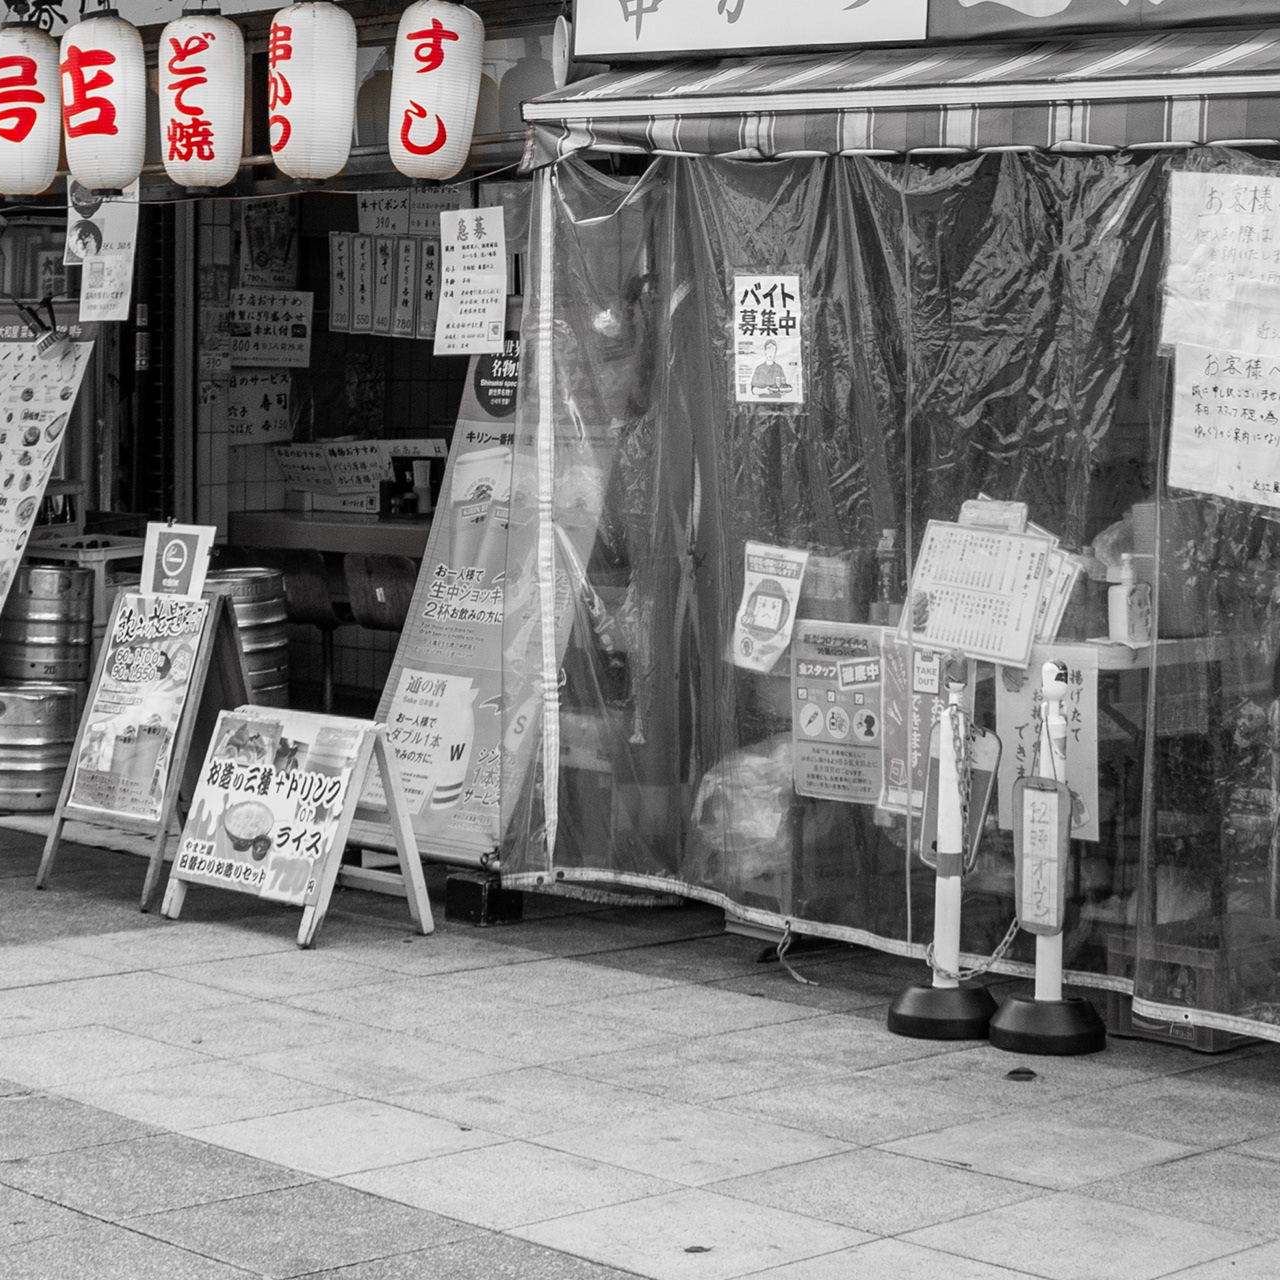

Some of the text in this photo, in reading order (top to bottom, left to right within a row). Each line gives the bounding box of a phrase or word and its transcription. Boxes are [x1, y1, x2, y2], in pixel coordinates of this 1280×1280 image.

[166, 33, 216, 162] どて焼
[406, 18, 459, 156] すし
[457, 217, 487, 241] 急募
[740, 282, 795, 308] バイト
[739, 309, 797, 336] 募集中
[436, 565, 484, 582] お一人様で
[429, 582, 503, 604] 生中ジョッキ
[424, 601, 504, 625] 2杯お飲みの方に
[798, 663, 837, 678] 全スタッフ
[842, 663, 880, 684] 徹底中
[917, 666, 937, 676] TAKE
[918, 677, 935, 687] OUT
[1069, 669, 1083, 744] 揚げたて
[396, 712, 437, 729] お一人様で
[450, 743, 465, 762] W
[300, 806, 314, 823] or
[185, 841, 213, 856] やまと屋
[276, 826, 323, 855] ライス
[179, 855, 266, 885] 日替わりお造りセット
